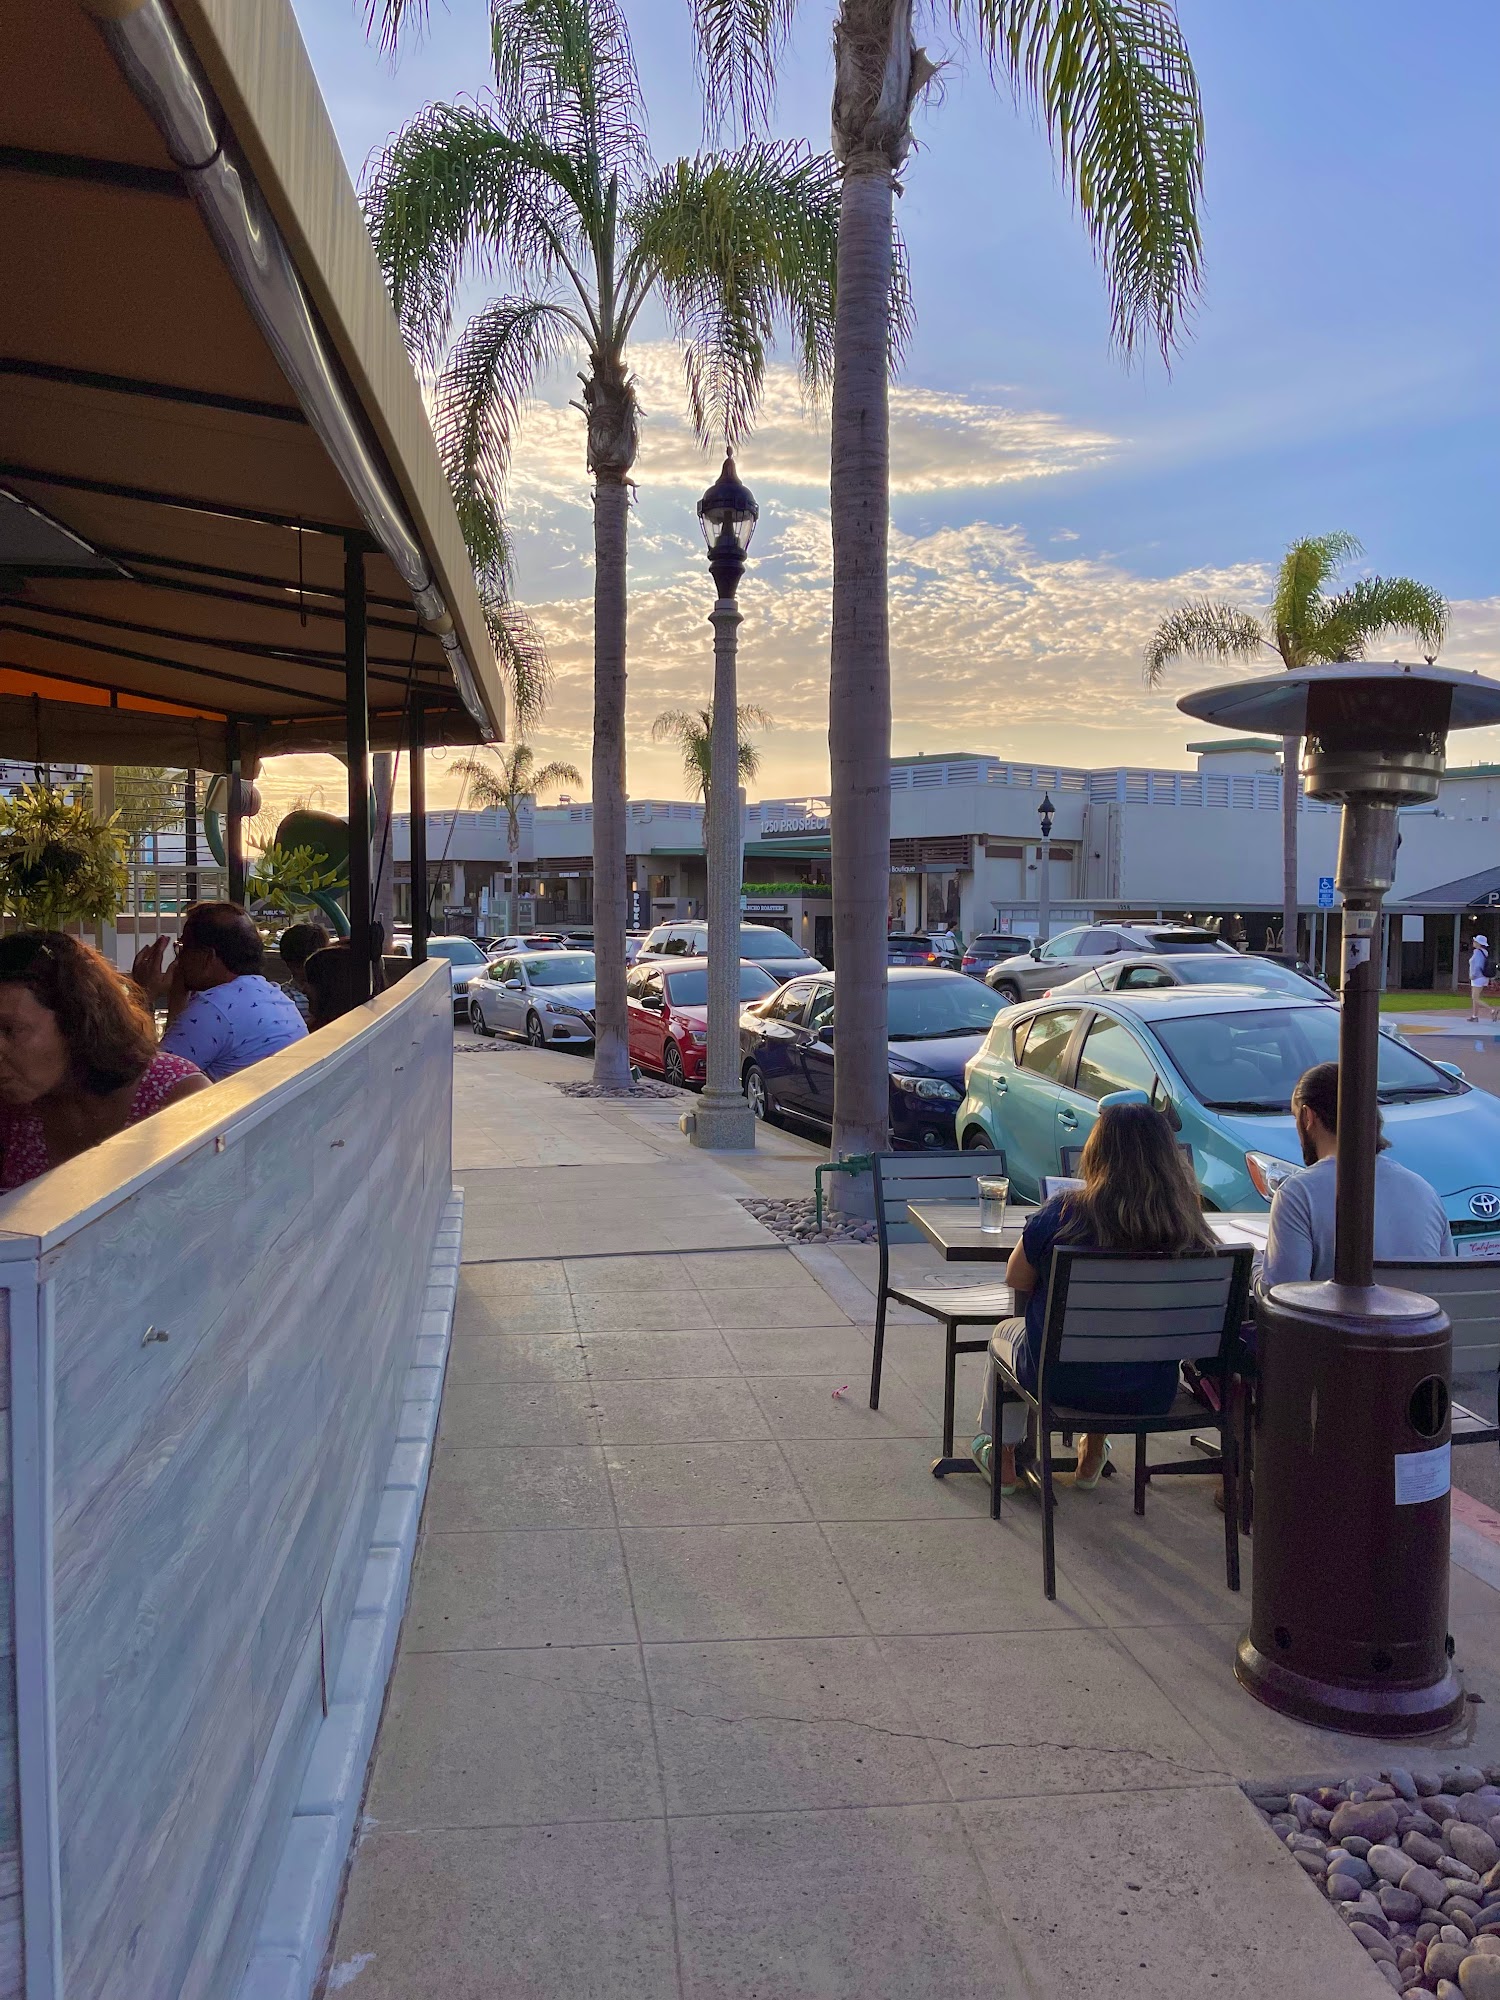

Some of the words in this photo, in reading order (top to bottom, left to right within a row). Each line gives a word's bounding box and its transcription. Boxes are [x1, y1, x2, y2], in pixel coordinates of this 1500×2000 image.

[761, 820, 779, 833] 1250
[780, 817, 828, 832] PROSPECT
[891, 865, 916, 873] Boutique
